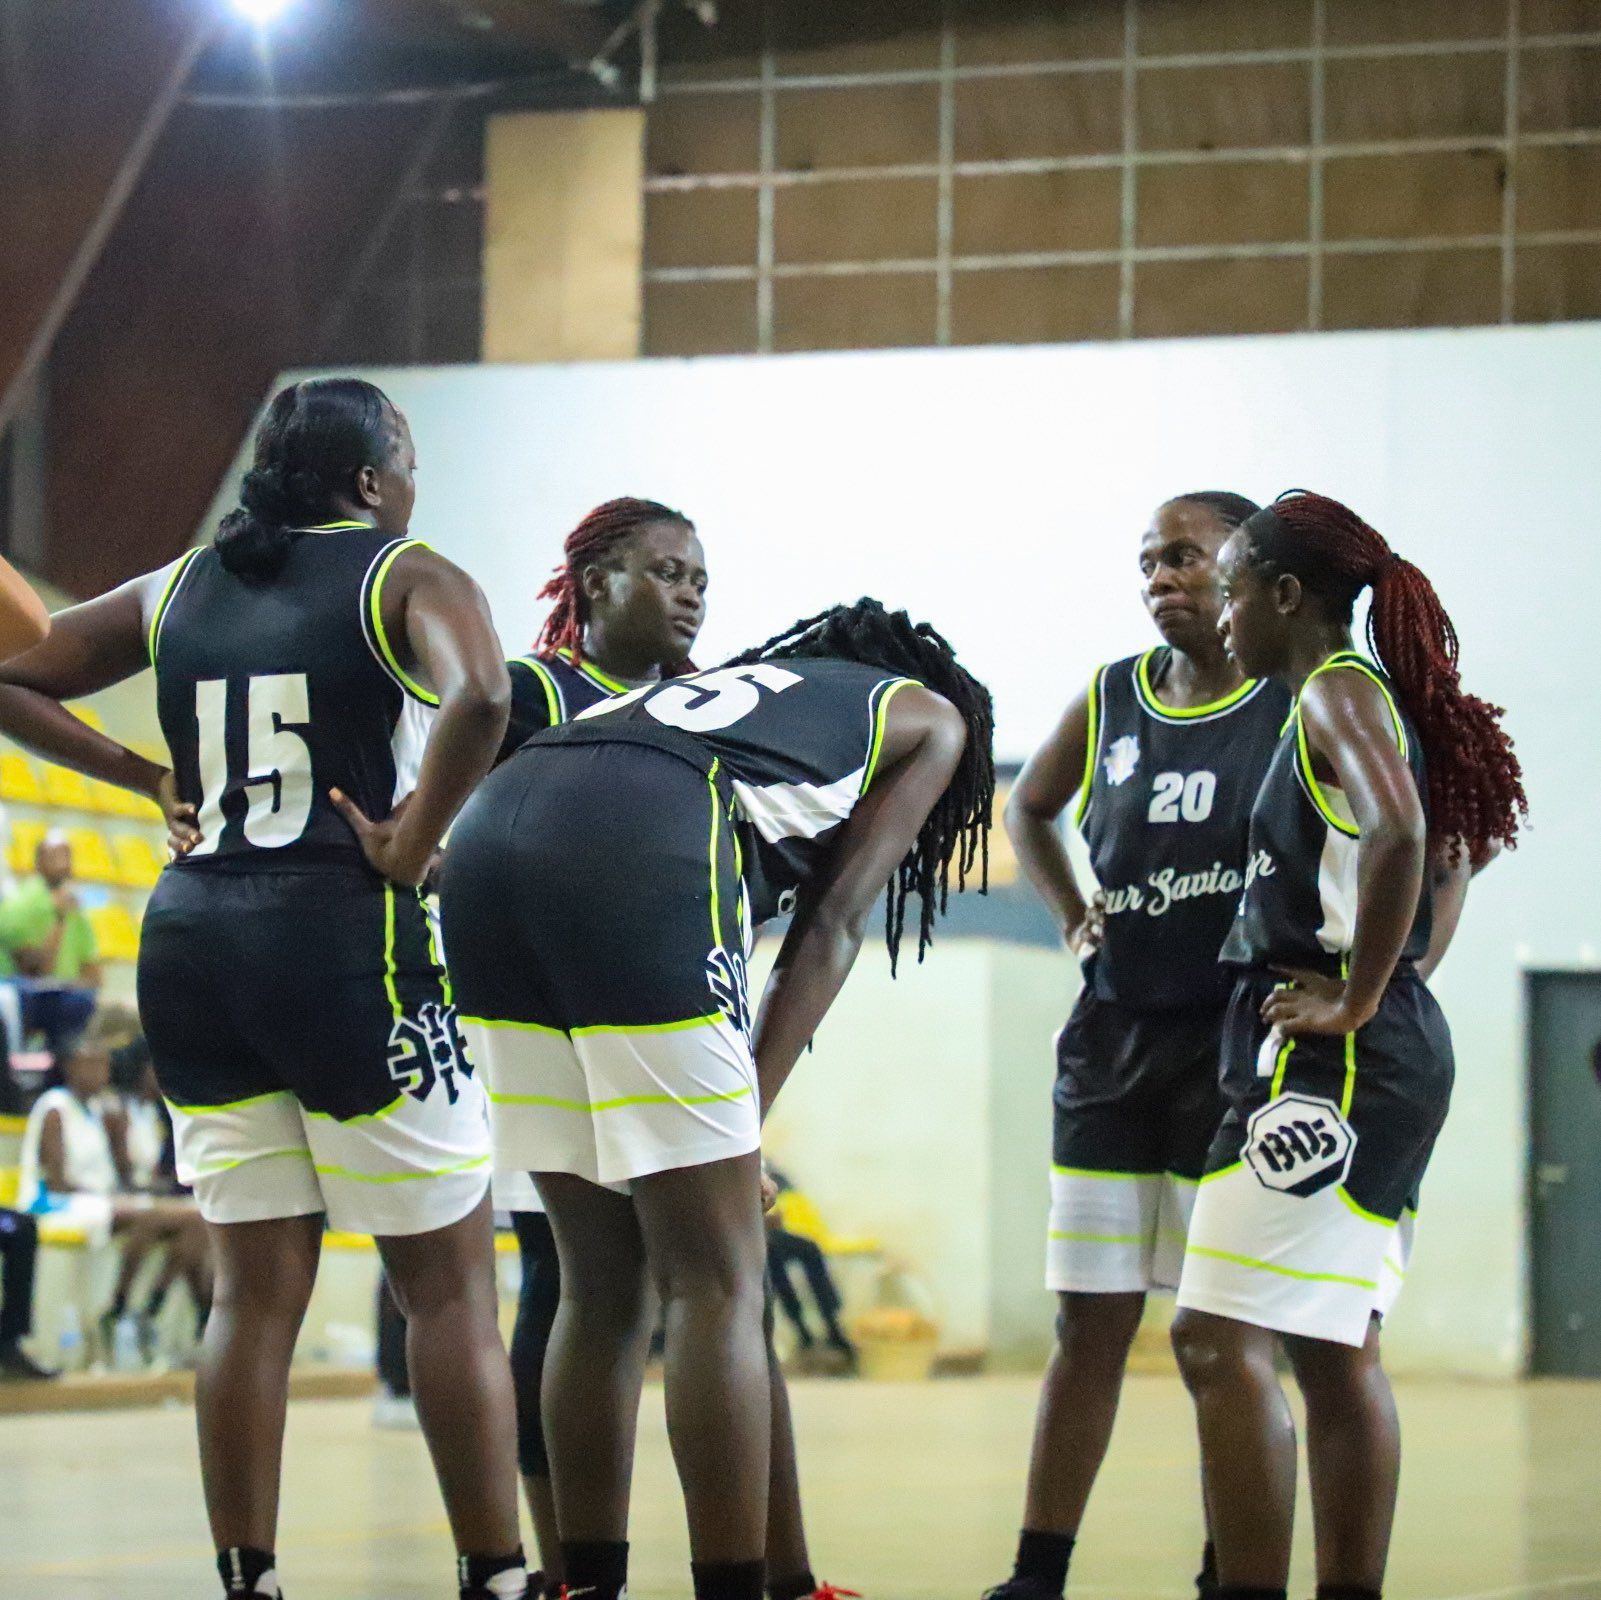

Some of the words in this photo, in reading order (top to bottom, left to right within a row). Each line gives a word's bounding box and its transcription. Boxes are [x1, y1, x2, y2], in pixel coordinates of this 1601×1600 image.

[186, 672, 313, 857] 15
[1147, 770, 1217, 824] 20
[1103, 884, 1145, 915] ur
